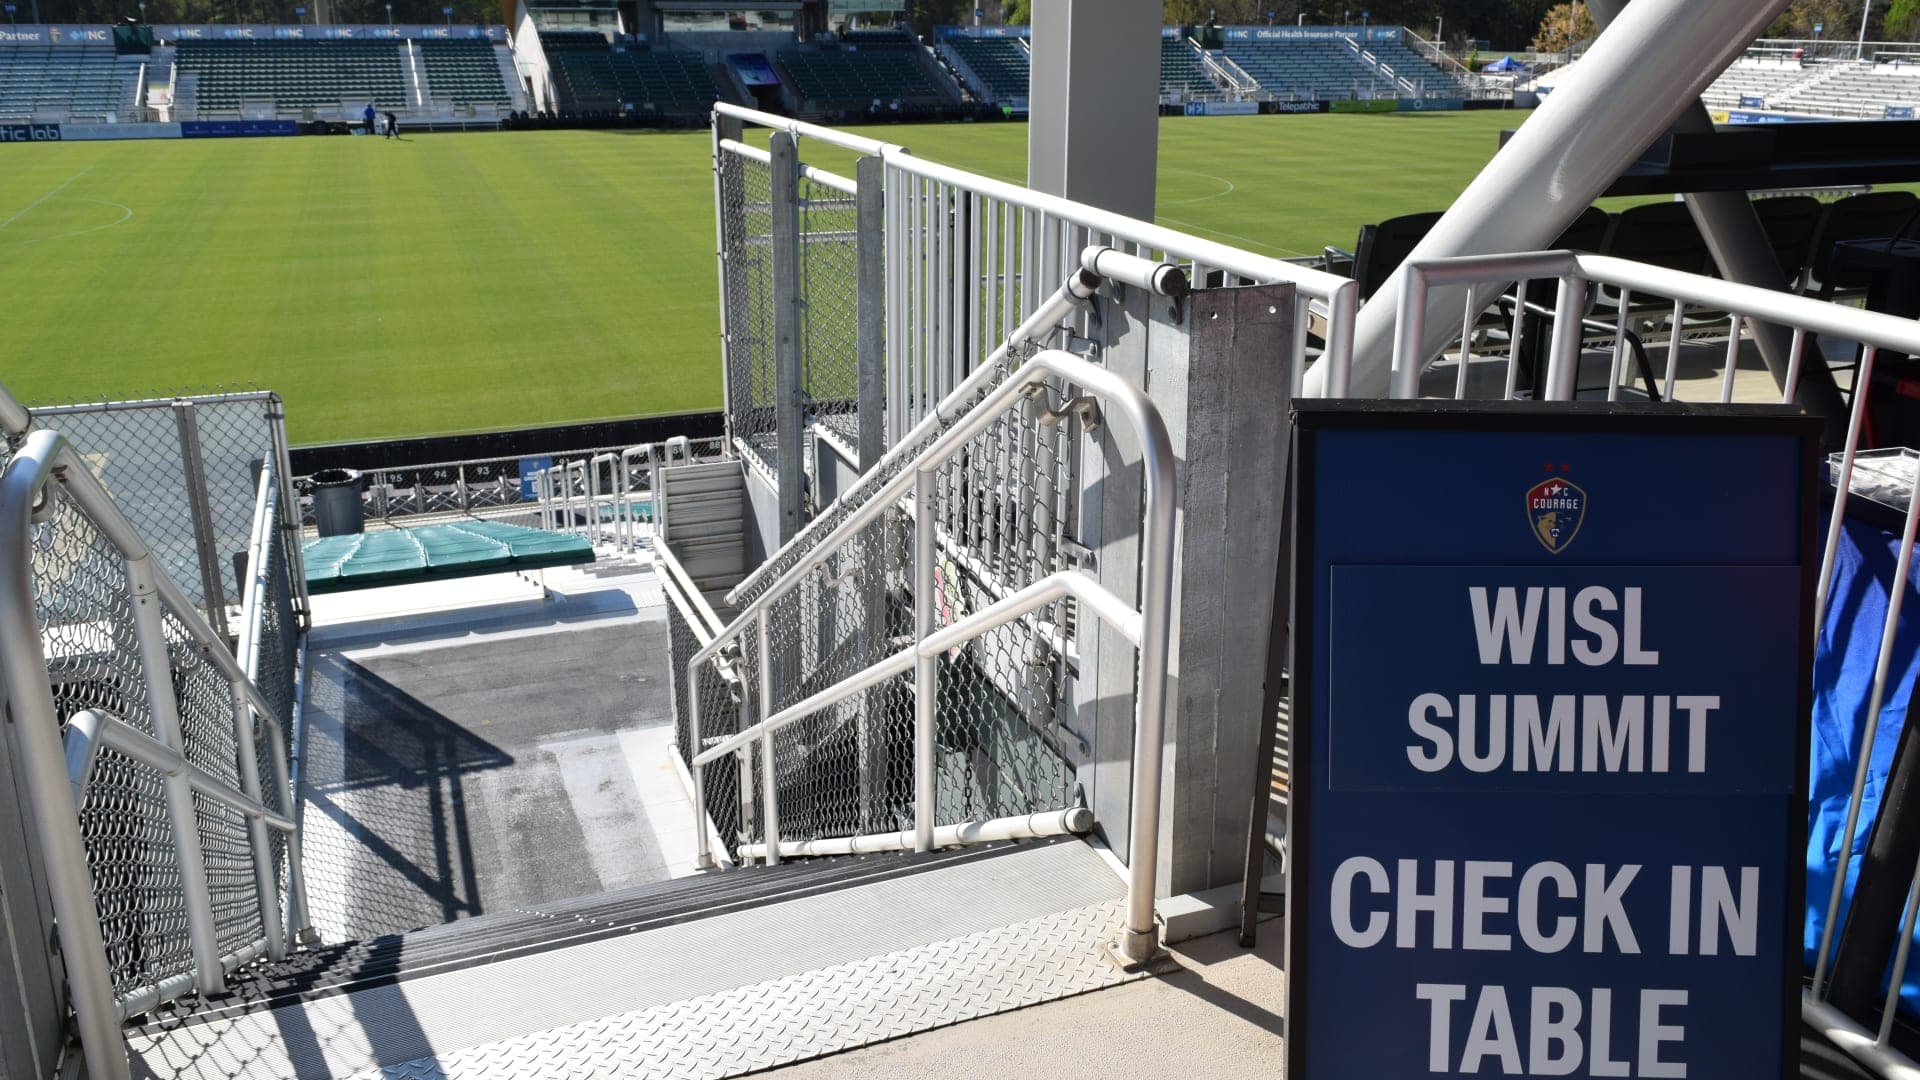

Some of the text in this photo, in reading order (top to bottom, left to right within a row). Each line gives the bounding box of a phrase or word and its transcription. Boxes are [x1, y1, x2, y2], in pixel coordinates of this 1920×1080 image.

[0, 31, 40, 40] Partner
[1257, 30, 1281, 39] Official
[1281, 30, 1303, 38] Health
[1303, 30, 1334, 38] Insurance
[1279, 101, 1321, 113] Telepathic
[1533, 498, 1579, 510] COURAGE
[1468, 585, 1660, 666] WISL
[1406, 692, 1721, 773] SUMMIT
[1330, 856, 1760, 956] CHECK IN
[1416, 983, 1690, 1079] TABLE
